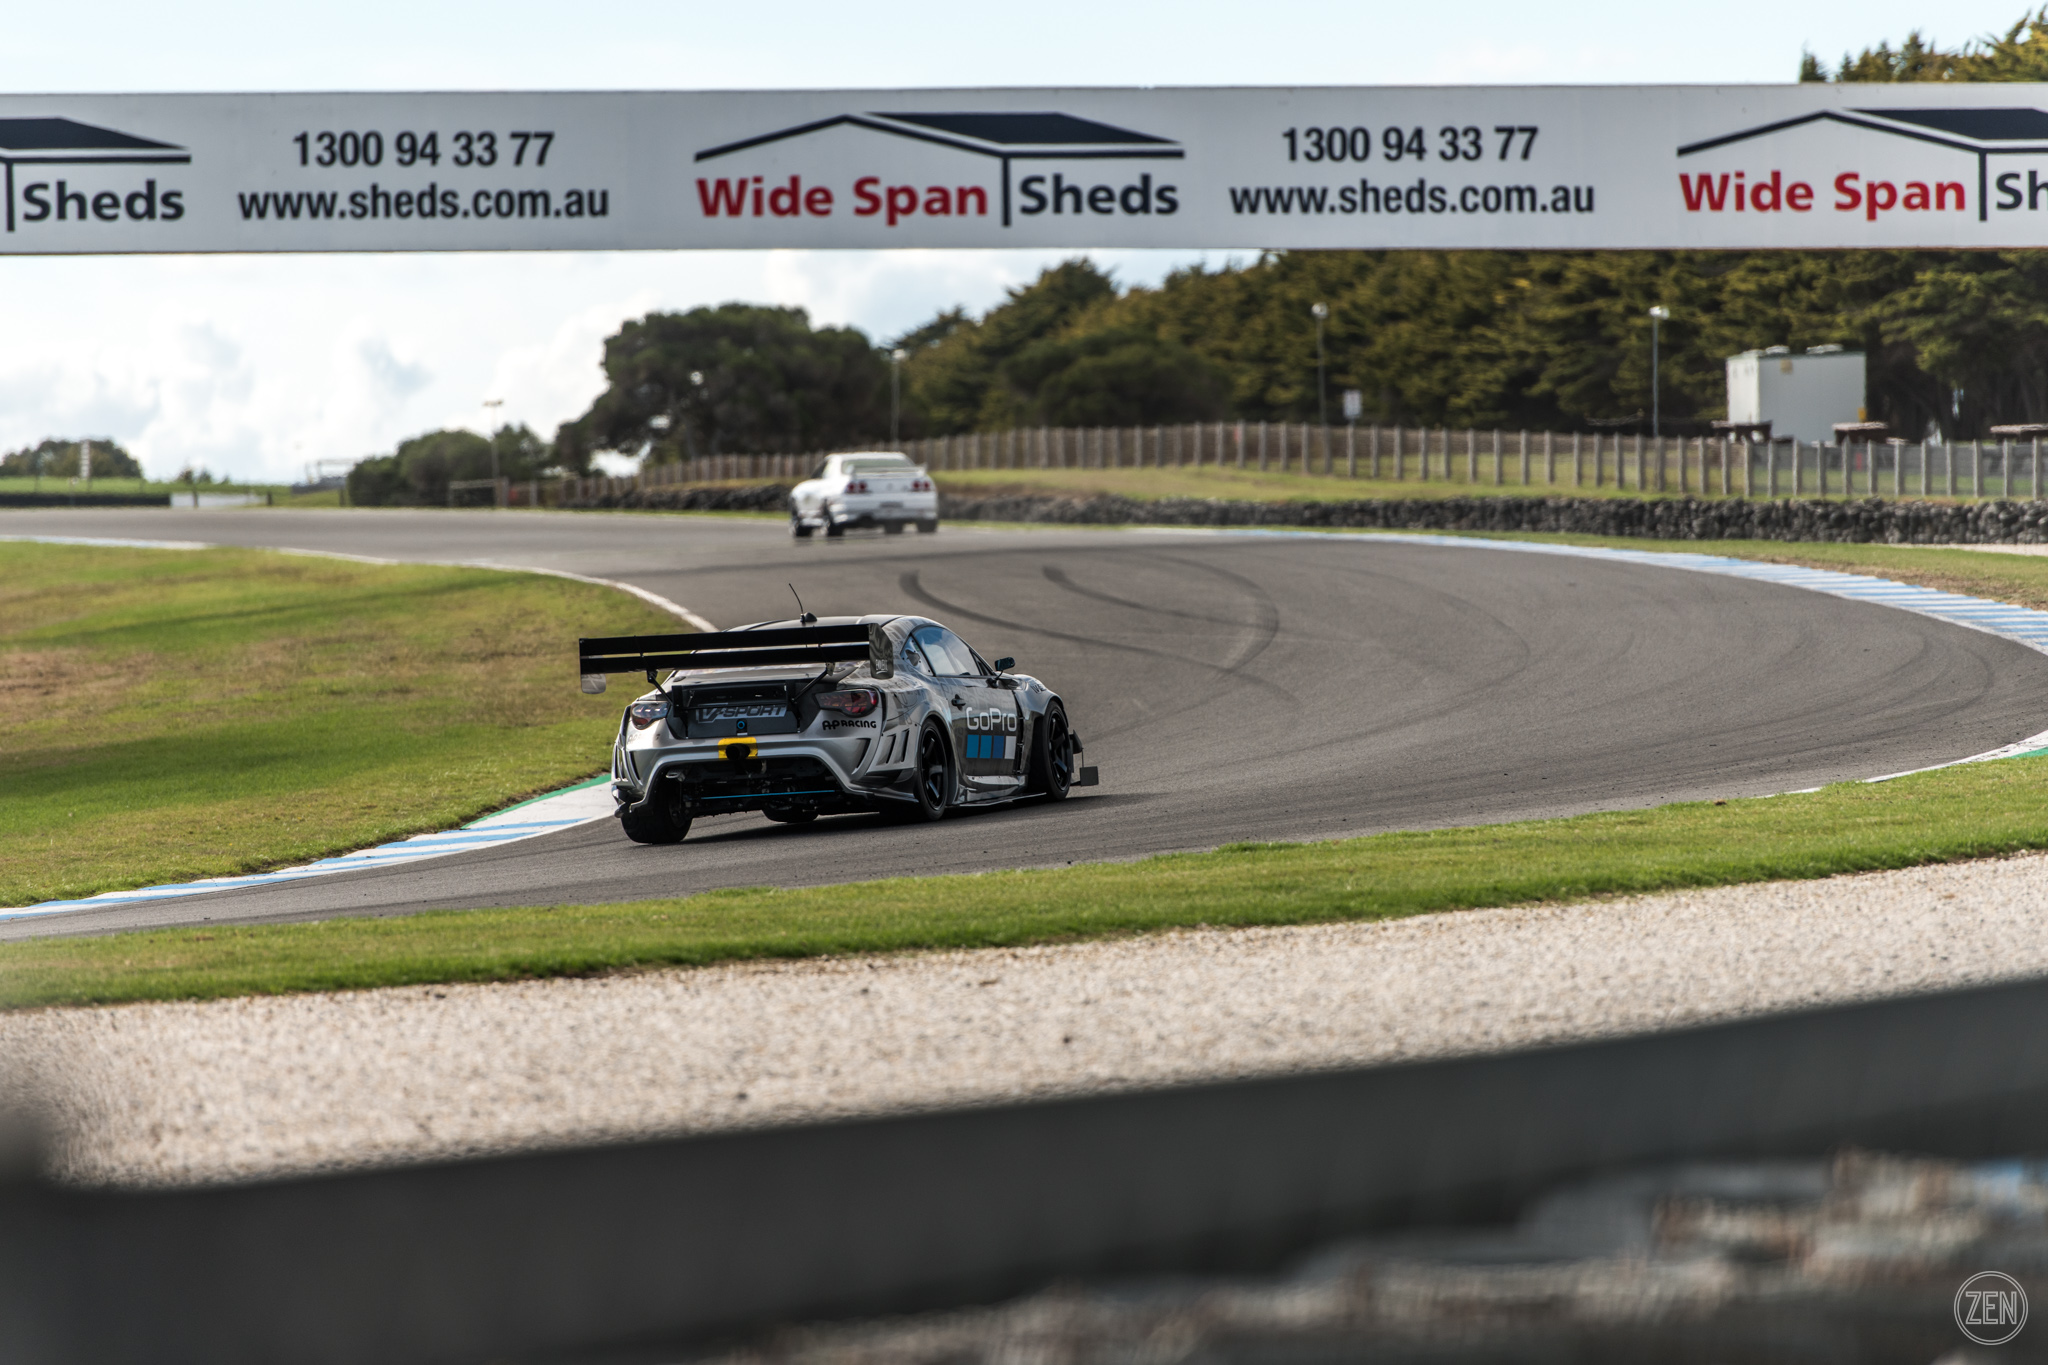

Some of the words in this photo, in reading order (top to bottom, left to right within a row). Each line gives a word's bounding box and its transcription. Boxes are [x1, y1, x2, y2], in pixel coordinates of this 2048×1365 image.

[293, 130, 385, 168] 1300
[394, 130, 442, 168] 94
[452, 130, 499, 168] 33
[508, 130, 556, 167] 77
[1281, 125, 1372, 163] 1300
[1381, 125, 1428, 163] 94
[1438, 125, 1484, 162] 33
[1493, 125, 1540, 162] 77
[22, 178, 186, 223] Sheds
[237, 181, 610, 221] www.sheds.com.au
[694, 174, 835, 218] Wide
[852, 175, 988, 228] Span
[1018, 172, 1180, 217] Sheds
[1228, 177, 1595, 215] www.sheds.com.au
[1677, 168, 1815, 213] Wide
[1833, 170, 1967, 222] Span
[822, 720, 840, 731] AP
[841, 720, 877, 729] RACING
[965, 706, 1017, 732] GoPro
